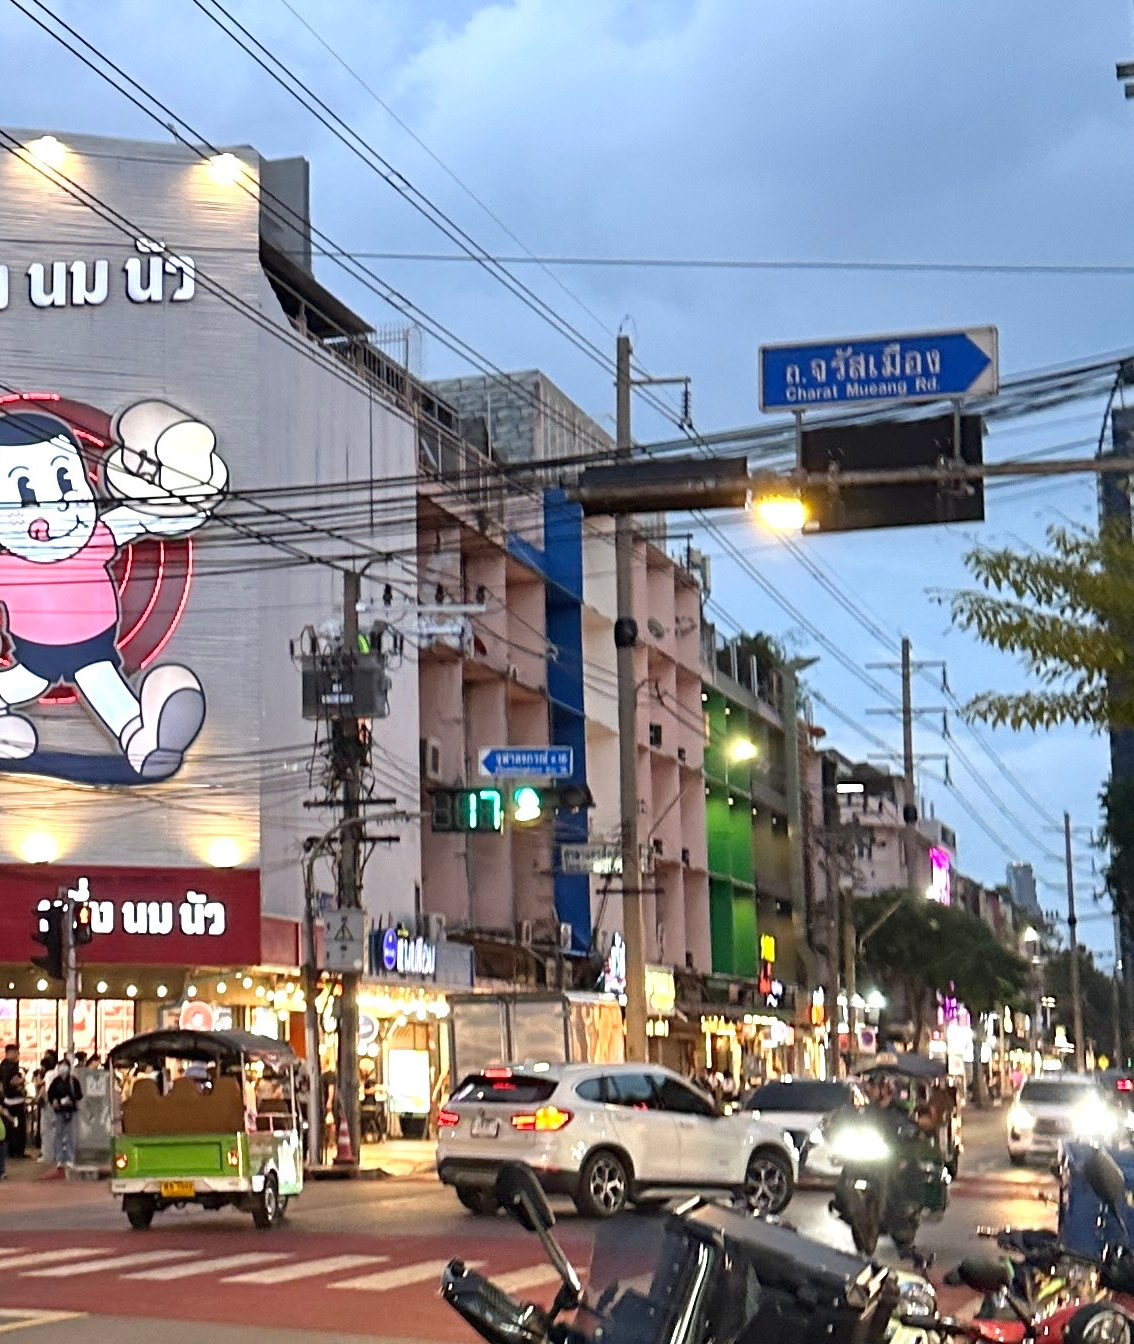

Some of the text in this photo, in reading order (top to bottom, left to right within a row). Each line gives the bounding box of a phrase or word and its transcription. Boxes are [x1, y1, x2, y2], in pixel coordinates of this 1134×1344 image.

[26, 259, 109, 307] นม
[124, 236, 196, 303] นัว
[785, 383, 839, 403] Charat
[845, 379, 908, 398] Mueang
[469, 790, 501, 830] 17
[121, 900, 173, 934] นม
[178, 890, 226, 936] นัว
